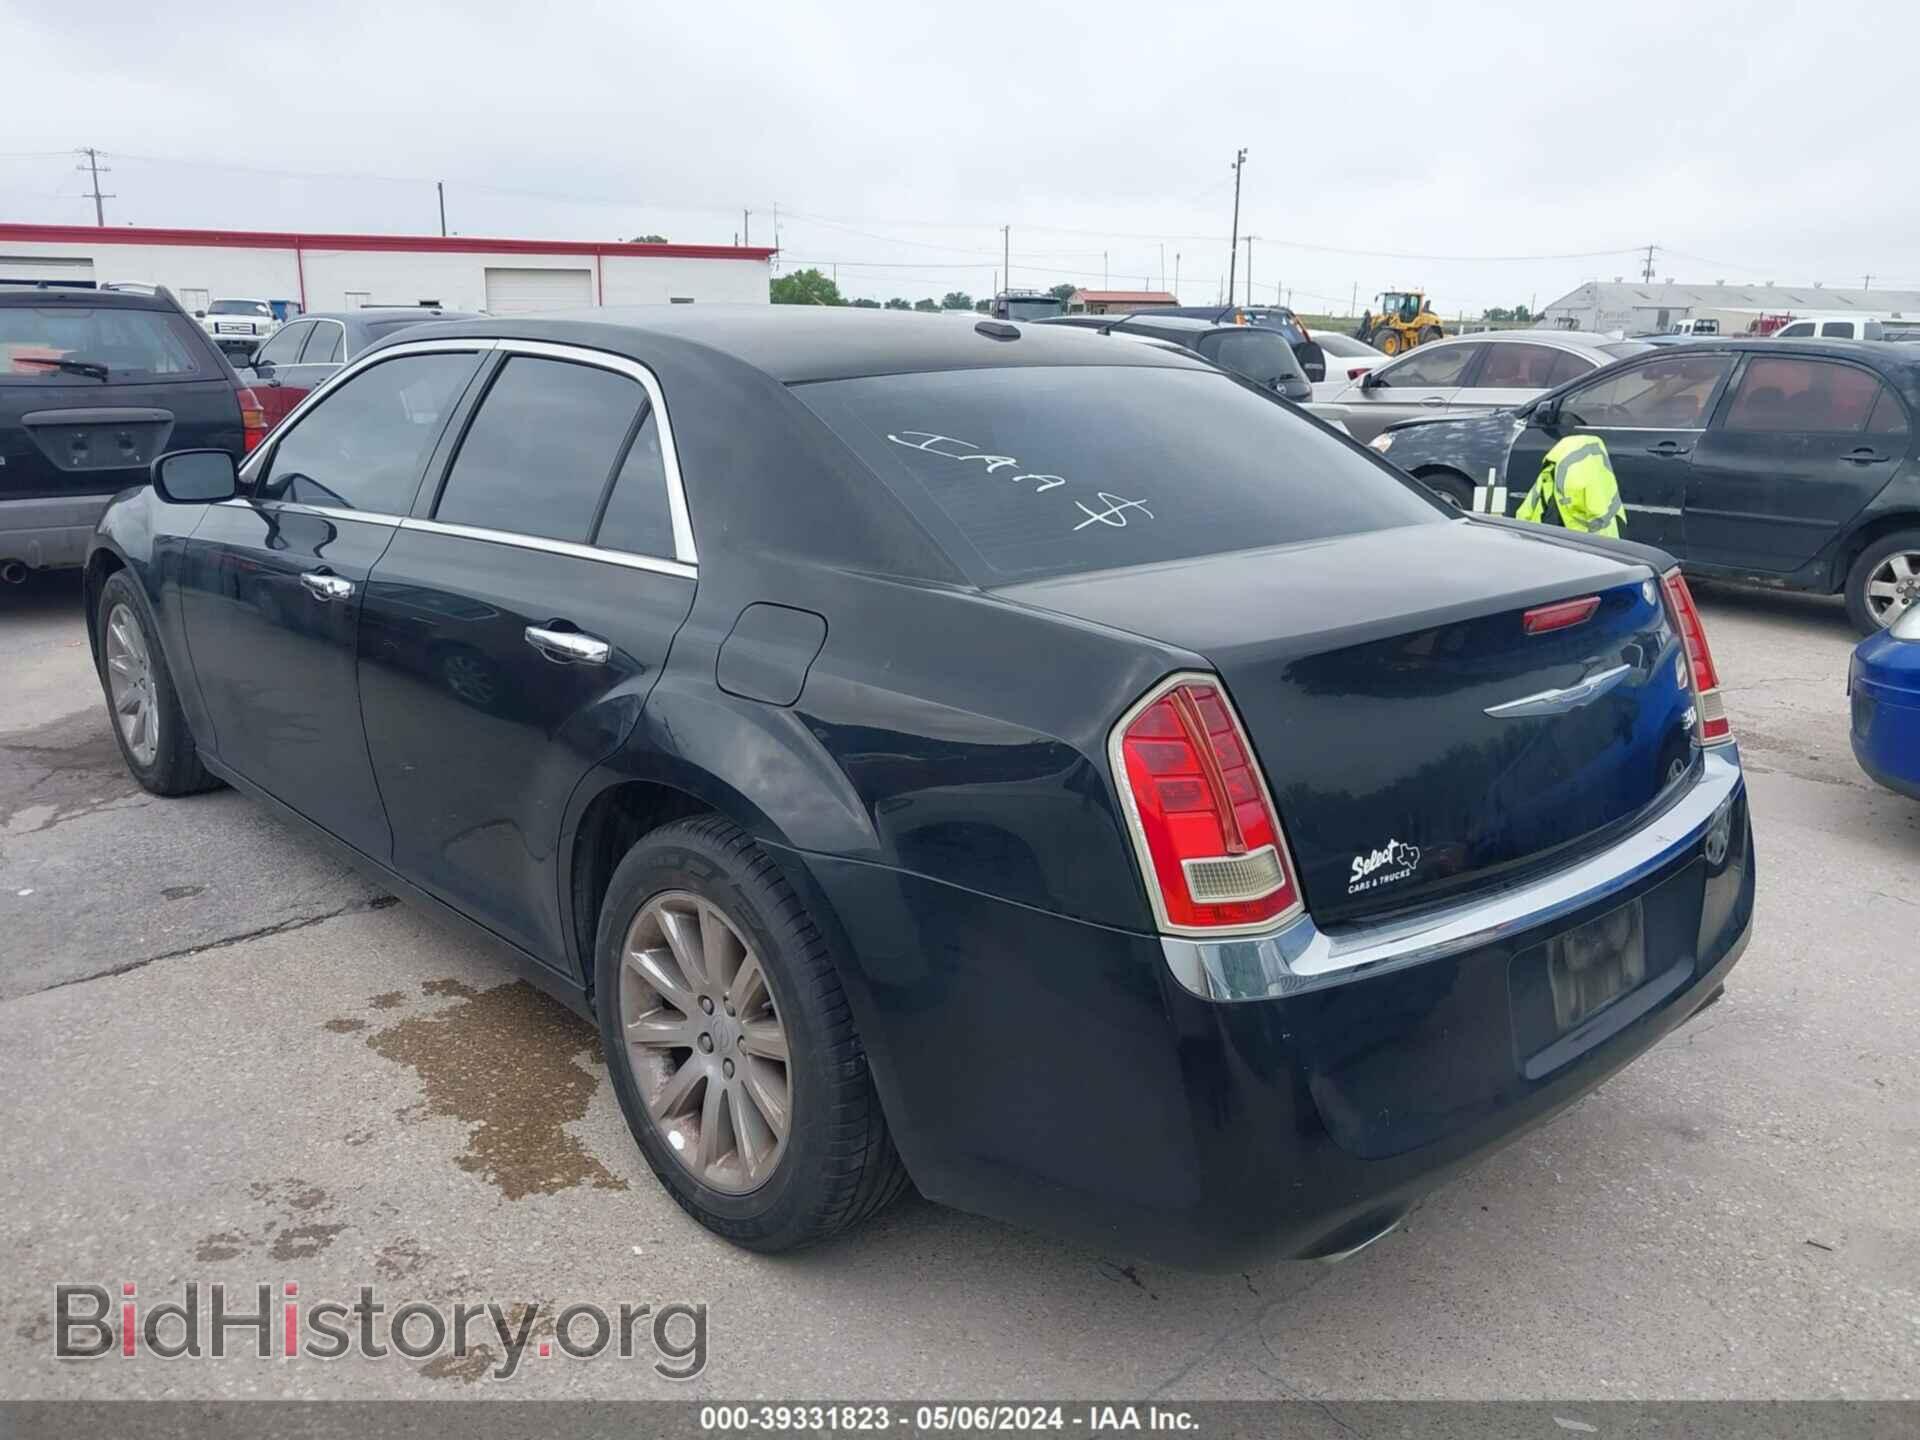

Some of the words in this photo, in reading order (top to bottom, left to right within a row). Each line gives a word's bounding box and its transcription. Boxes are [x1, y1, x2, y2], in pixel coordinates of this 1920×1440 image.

[1349, 838, 1399, 884] Select
[1348, 880, 1371, 894] CARS
[1372, 878, 1378, 887] &
[1379, 868, 1411, 885] TRUCKS
